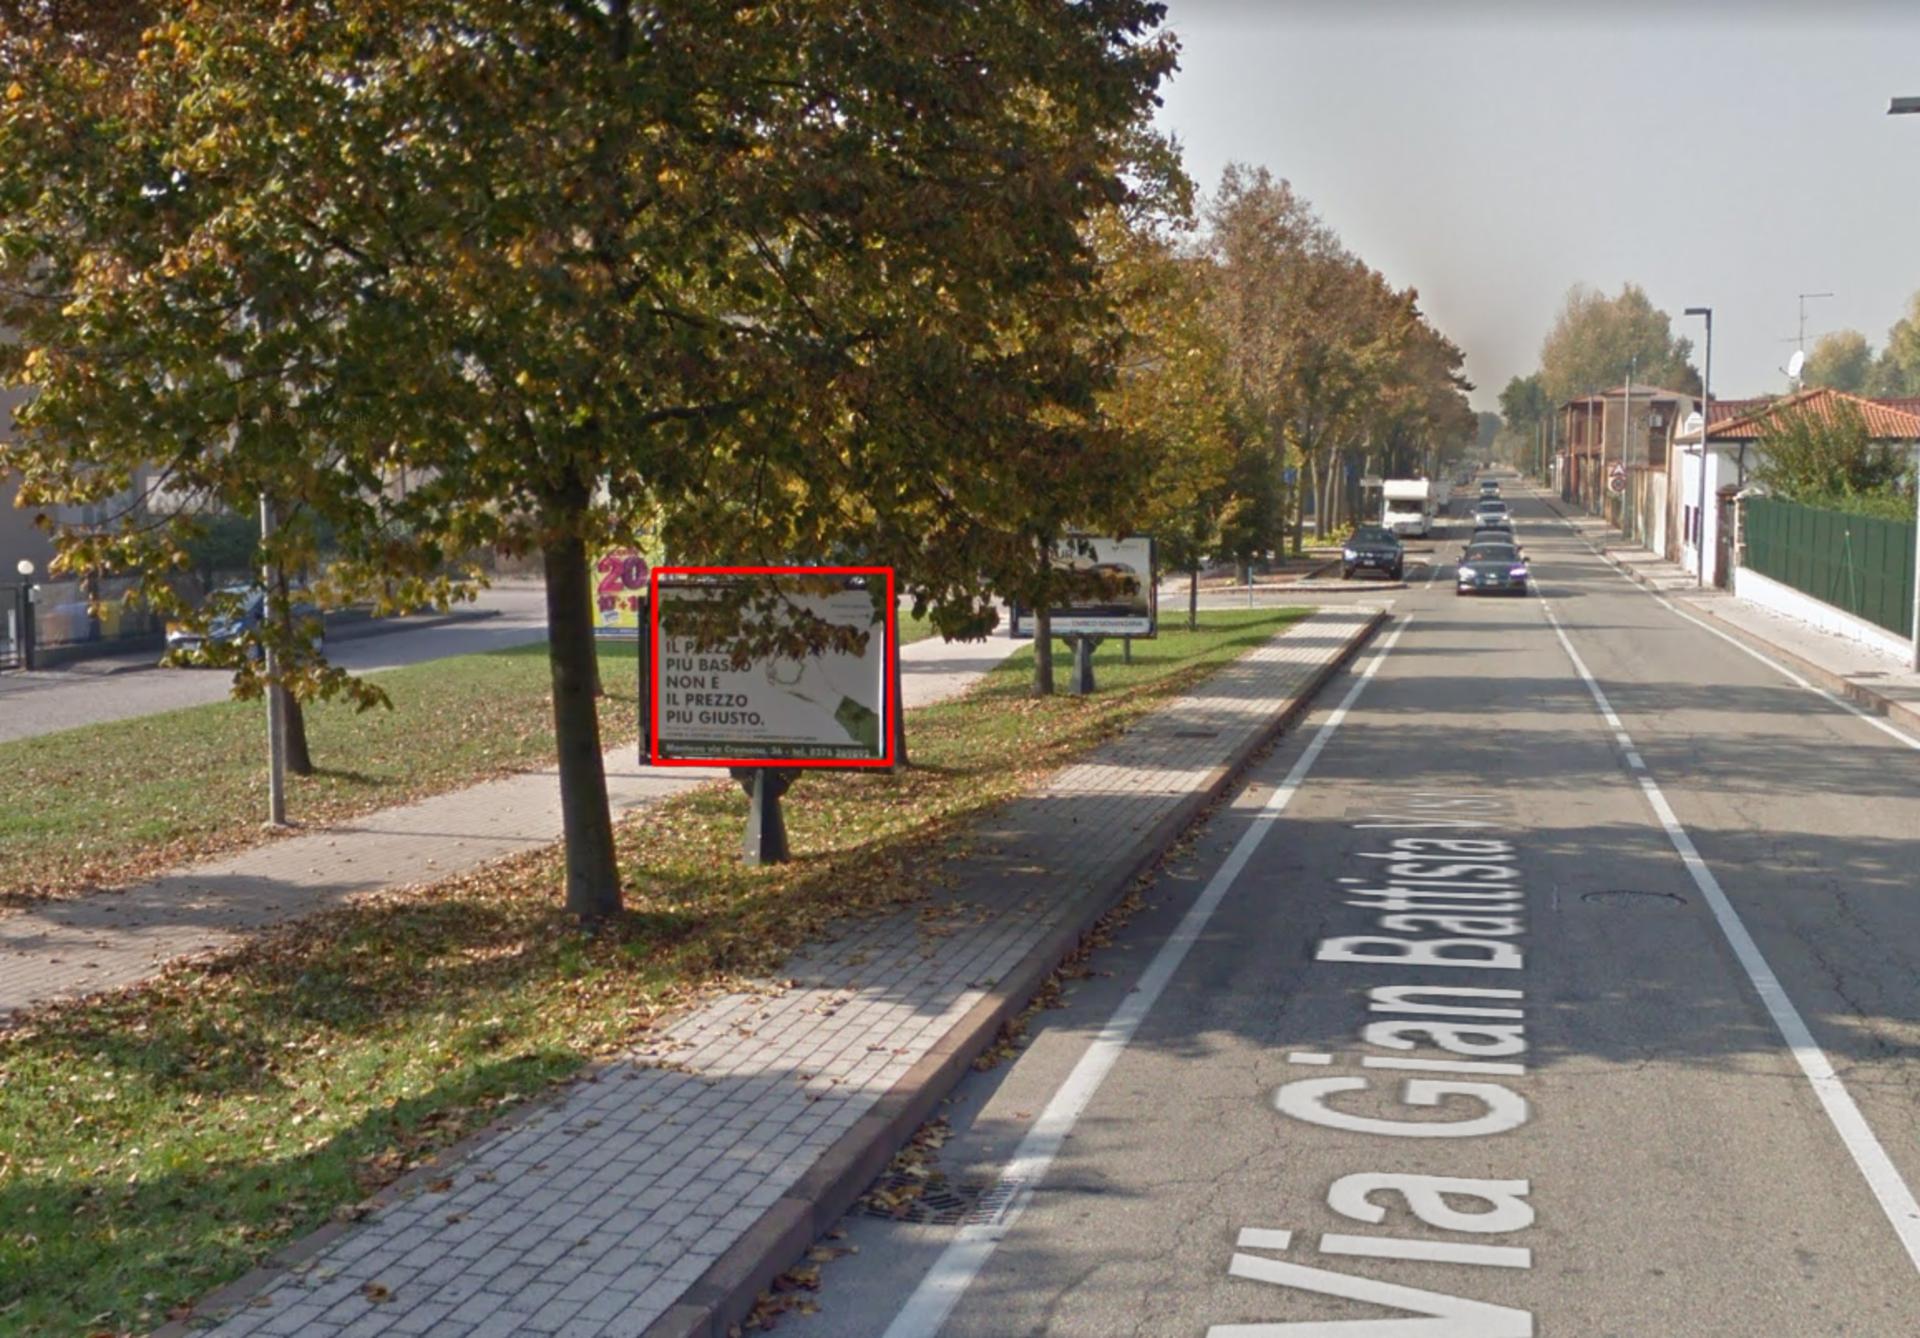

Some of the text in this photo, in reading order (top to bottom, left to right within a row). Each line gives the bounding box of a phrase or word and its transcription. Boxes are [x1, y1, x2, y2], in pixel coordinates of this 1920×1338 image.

[597, 556, 648, 593] 20
[666, 640, 680, 654] IL
[666, 675, 706, 690] NON
[666, 692, 748, 708] IL PREZZO
[699, 710, 765, 727] GIUSTO.
